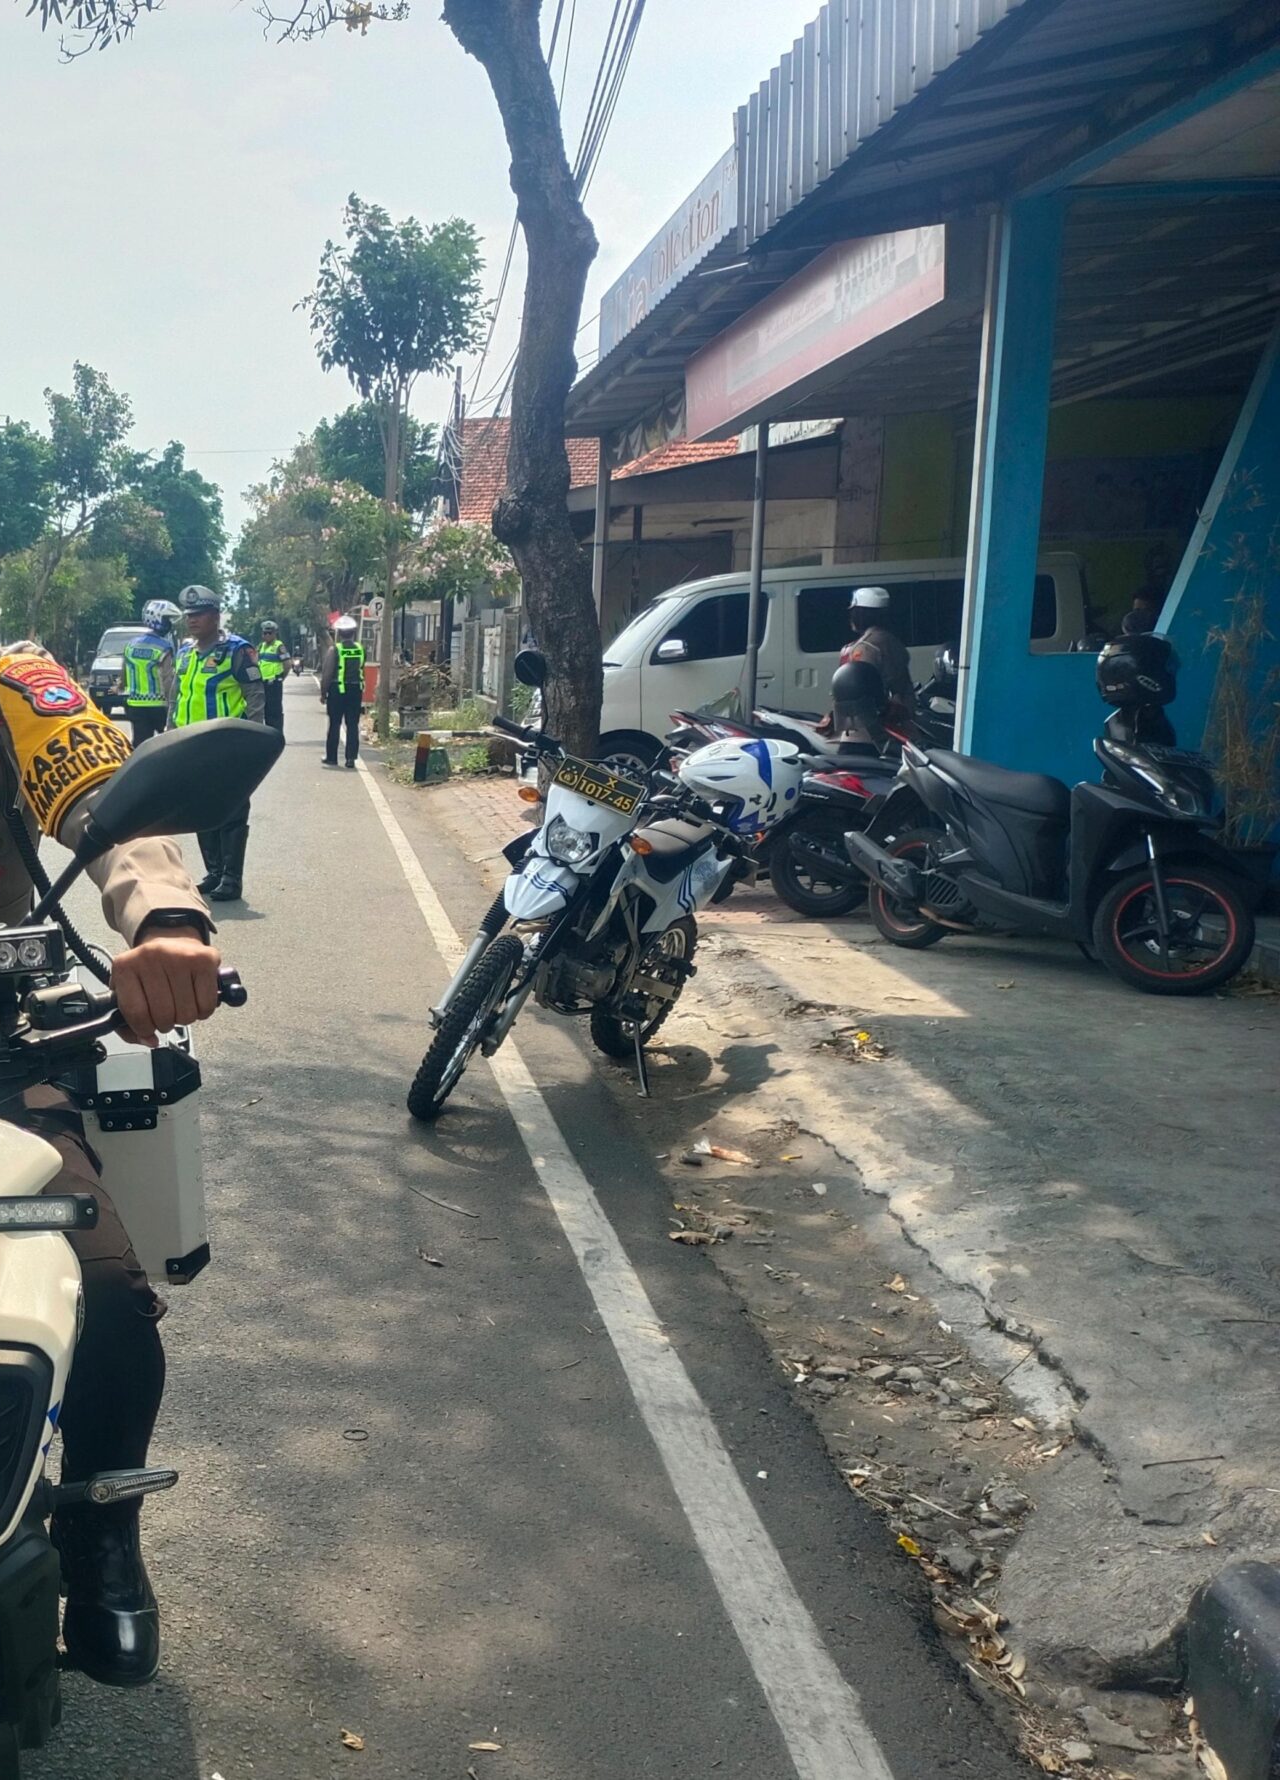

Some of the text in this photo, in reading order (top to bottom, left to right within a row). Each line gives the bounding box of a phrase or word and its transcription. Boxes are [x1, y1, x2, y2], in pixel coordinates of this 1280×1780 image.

[649, 189, 721, 295] Collection
[375, 602, 383, 616] P
[606, 777, 618, 788] X
[579, 779, 632, 811] 1017-45
